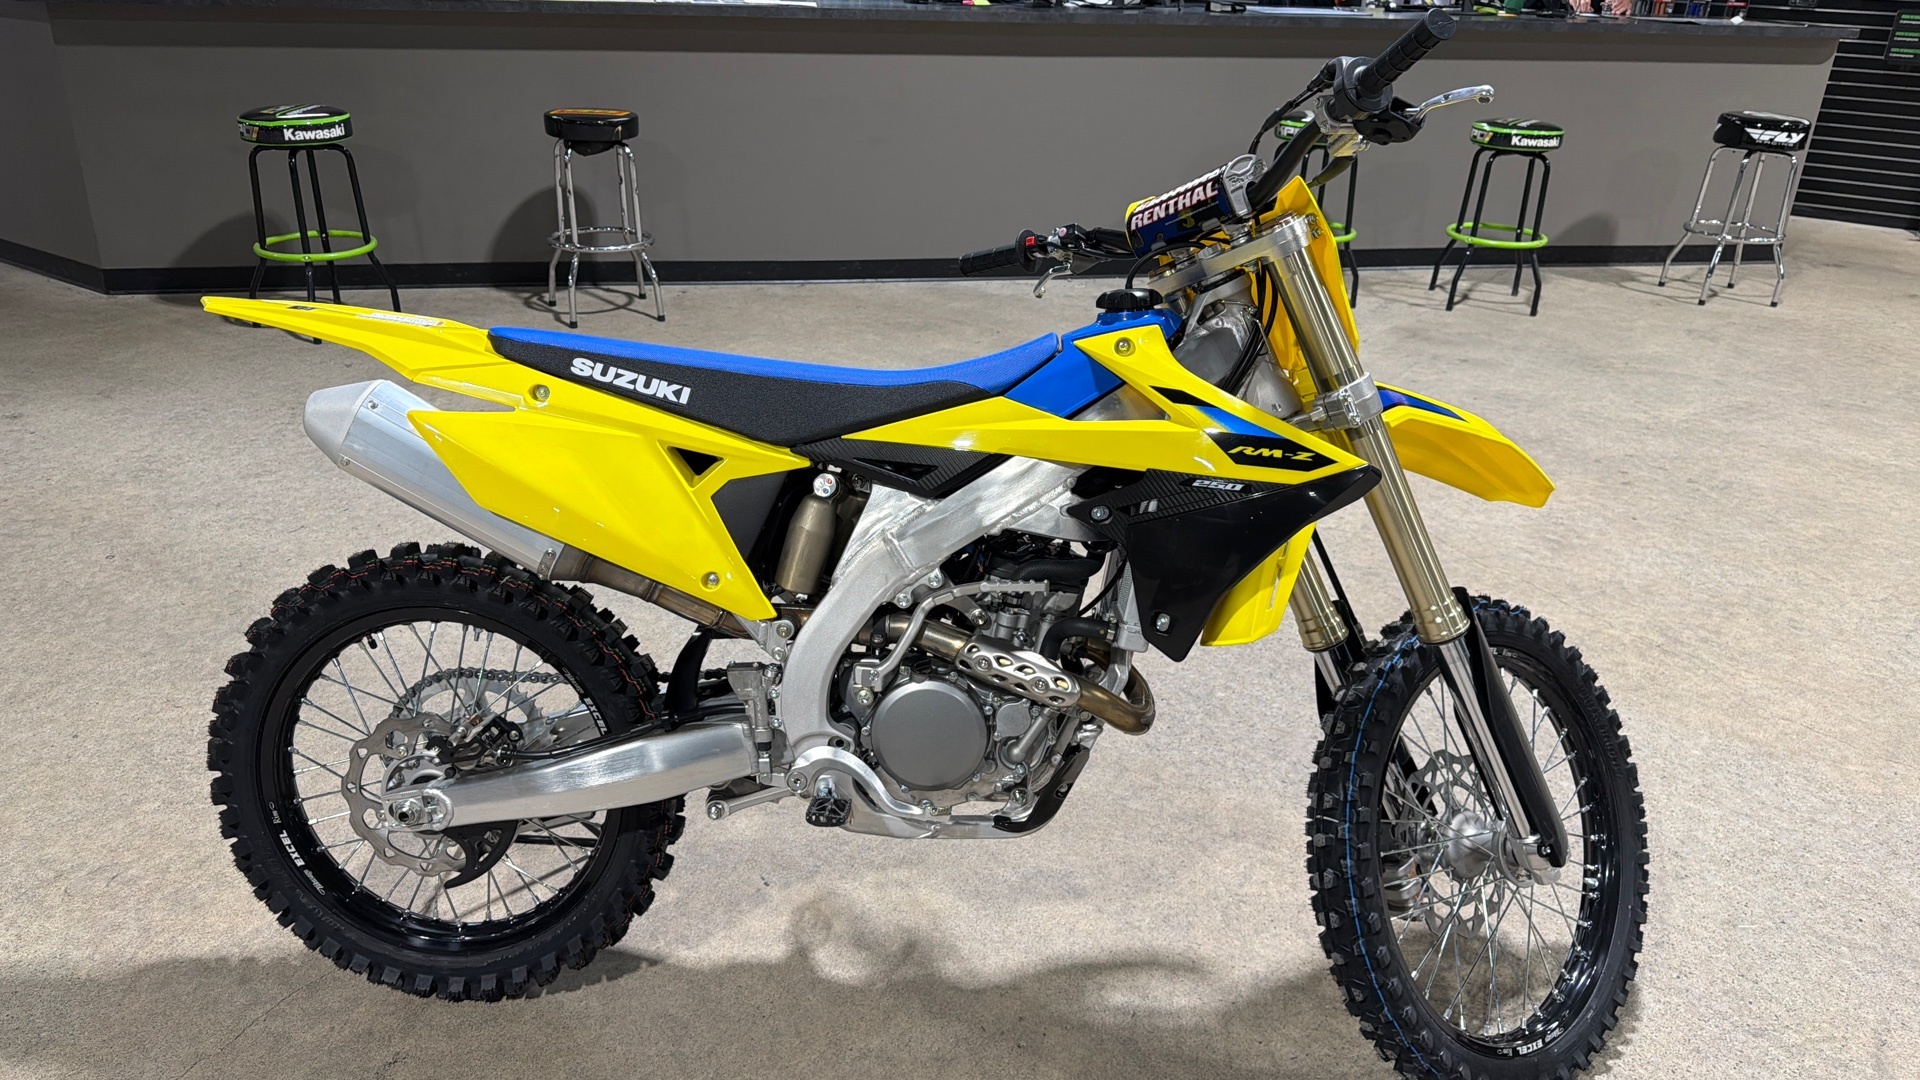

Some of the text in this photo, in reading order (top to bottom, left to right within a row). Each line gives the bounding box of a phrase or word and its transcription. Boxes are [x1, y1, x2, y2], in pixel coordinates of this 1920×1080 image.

[283, 123, 345, 141] Kawasaki
[1744, 128, 1806, 143] FLY
[1511, 135, 1560, 147] Kawasaki
[1130, 181, 1219, 231] RENTHAL
[570, 357, 691, 405] SUZUKI
[1227, 446, 1316, 461] RM-Z
[1192, 479, 1245, 491] 250
[583, 697, 608, 735] EXCEL
[279, 829, 306, 867] EXCEL
[1516, 1039, 1543, 1055] EXCEL
